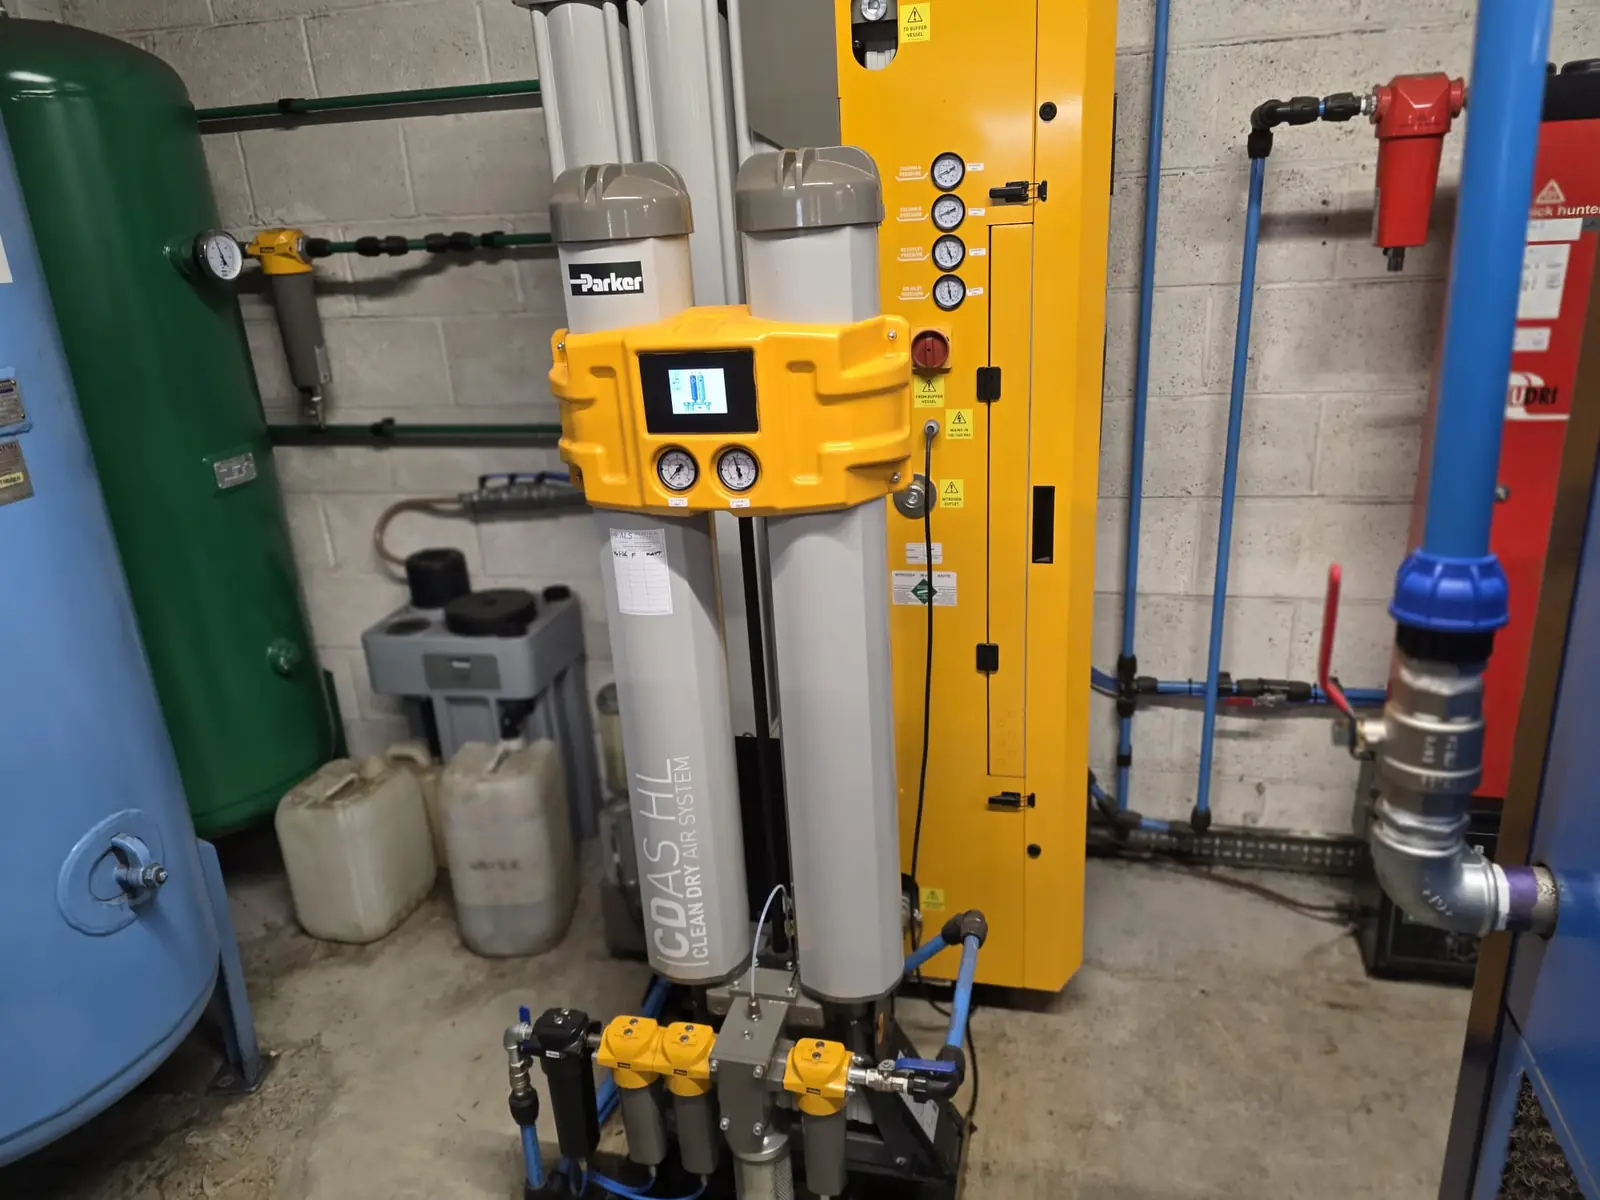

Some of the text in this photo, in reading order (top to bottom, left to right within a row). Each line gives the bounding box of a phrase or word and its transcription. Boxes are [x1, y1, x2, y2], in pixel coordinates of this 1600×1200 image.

[1557, 205, 1600, 215] hunte
[571, 272, 642, 292] Parker
[635, 758, 690, 958] CDAS HL
[673, 755, 709, 958] CLEAN DRY AIR SYSTEM
